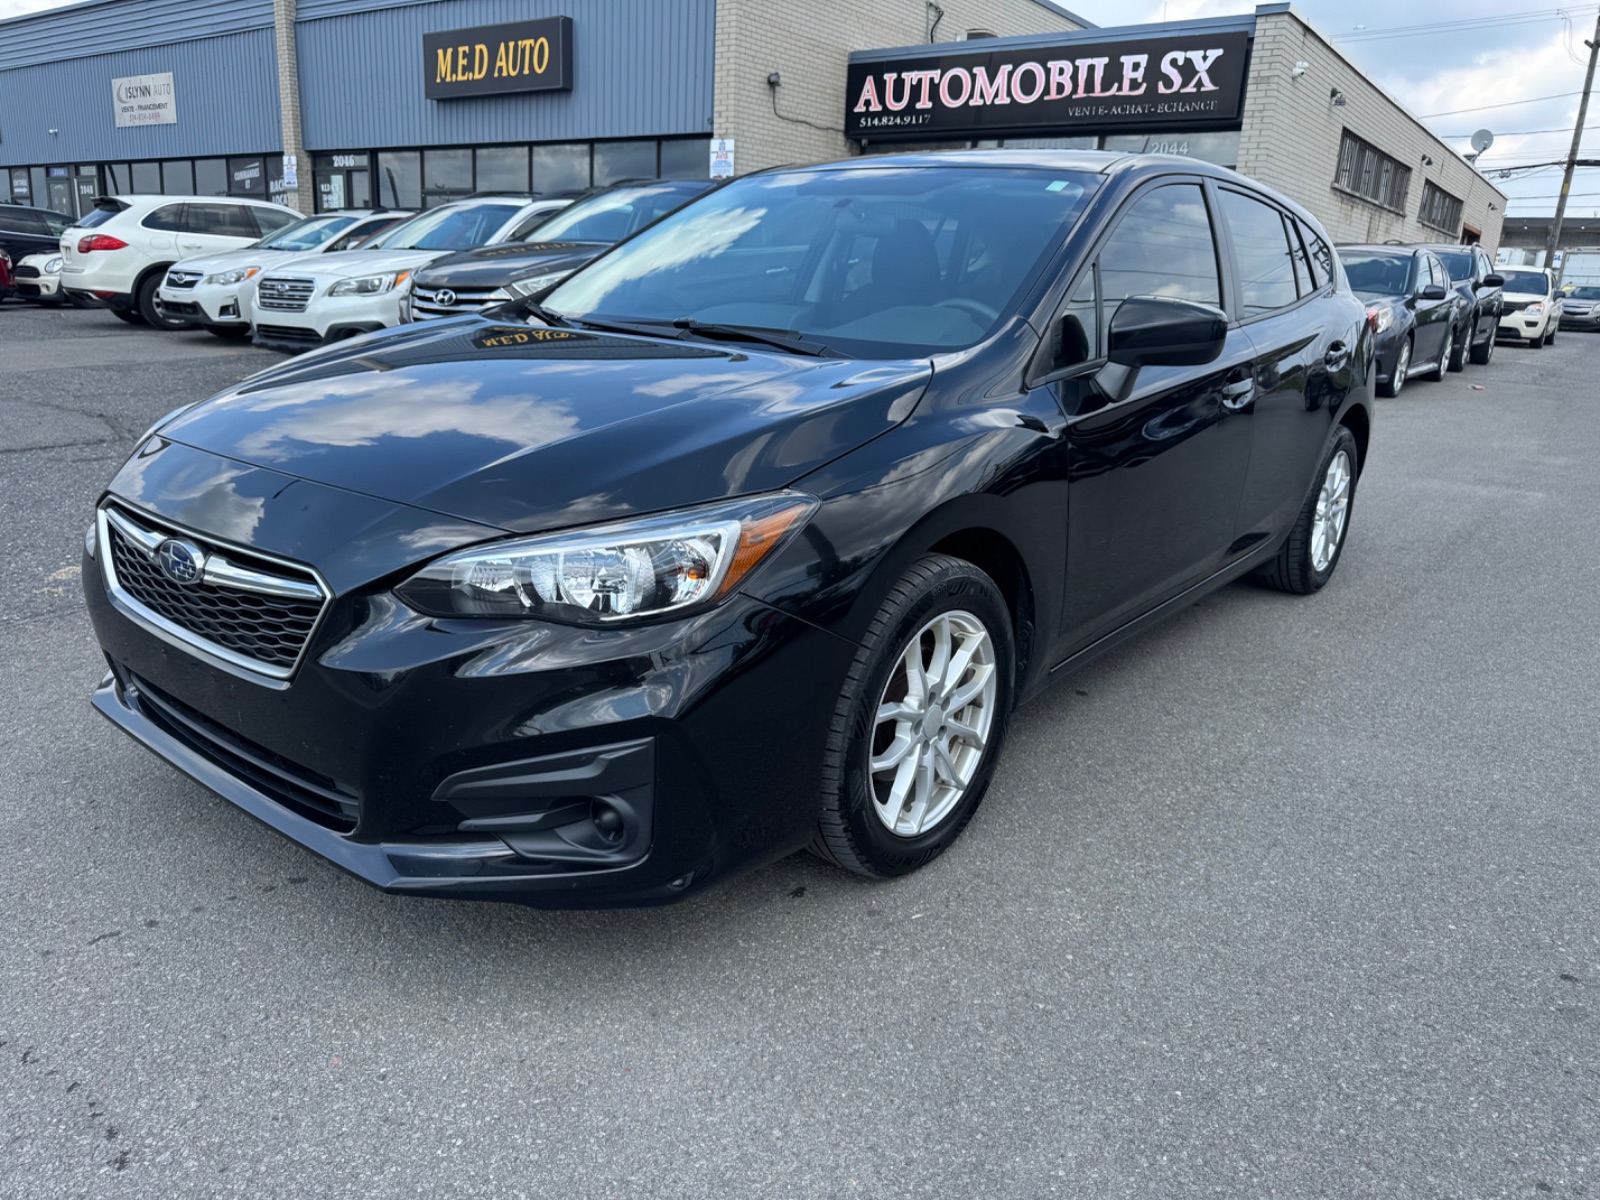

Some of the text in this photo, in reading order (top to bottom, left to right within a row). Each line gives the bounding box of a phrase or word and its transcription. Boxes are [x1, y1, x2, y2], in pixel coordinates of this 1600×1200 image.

[436, 36, 550, 83] M.E.D AUTO
[853, 48, 1224, 113] AUTOMOBILE SX
[859, 113, 931, 128] 514.824.9117
[1151, 141, 1190, 155] 2044
[332, 154, 355, 168] 2046
